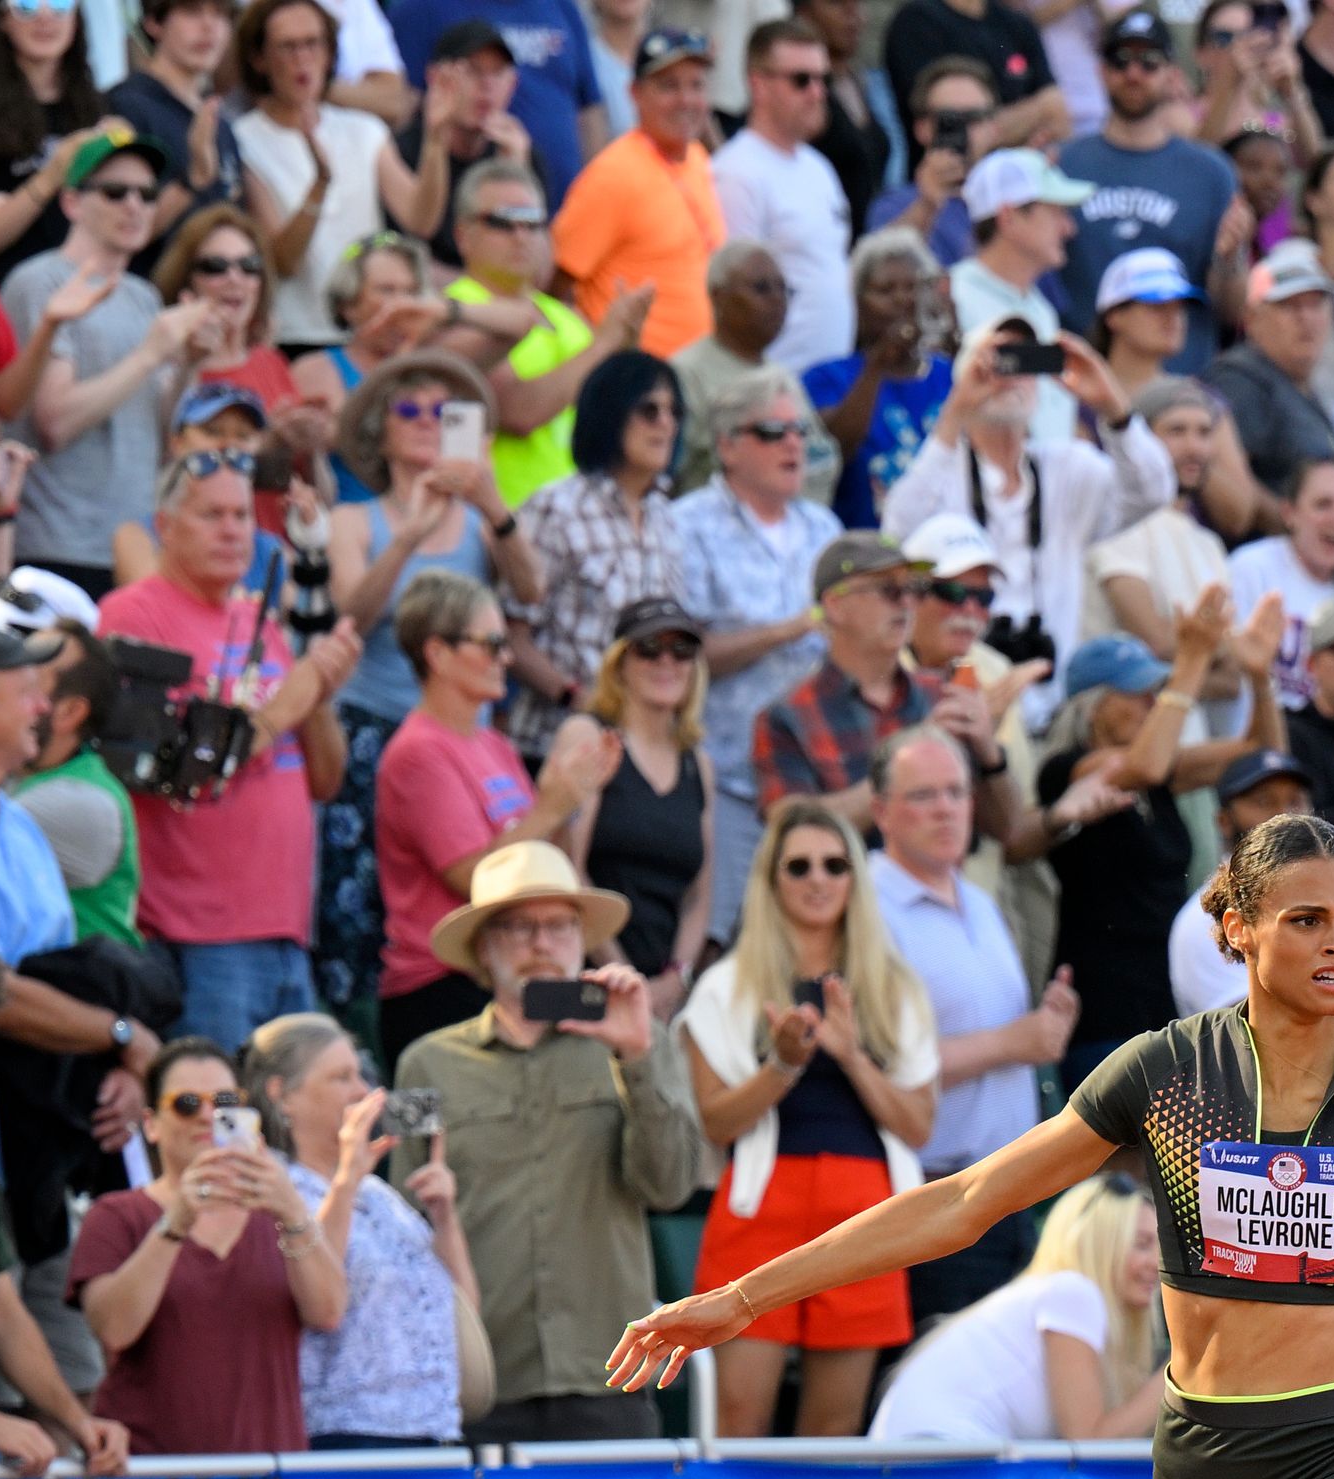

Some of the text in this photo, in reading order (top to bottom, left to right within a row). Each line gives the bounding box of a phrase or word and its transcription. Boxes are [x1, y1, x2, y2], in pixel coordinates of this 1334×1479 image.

[1224, 1154, 1260, 1166] USATF
[1319, 1153, 1334, 1163] U.S.
[1237, 1218, 1333, 1250] LEVRONE
[1211, 1245, 1257, 1265] TRACKTOWN
[1233, 1261, 1254, 1274] 2024
